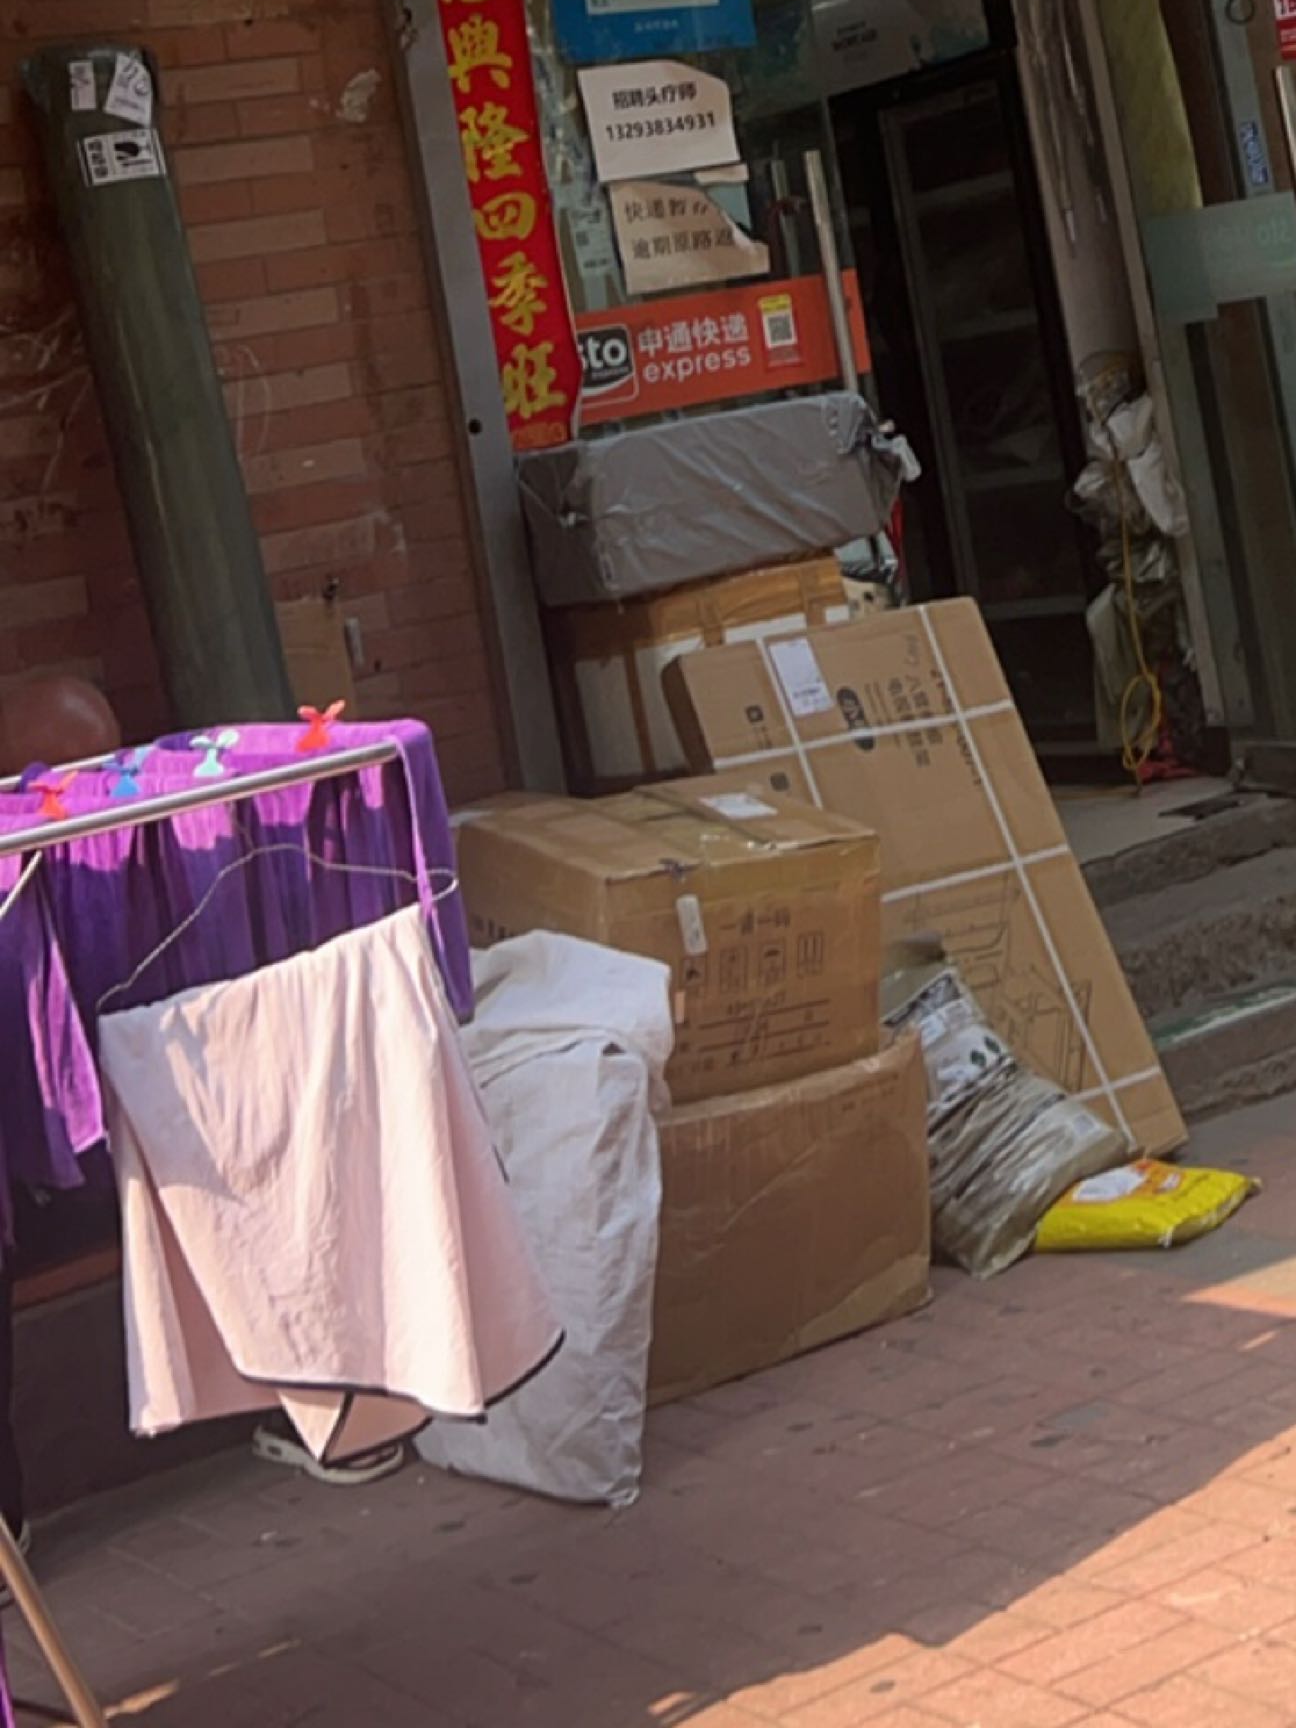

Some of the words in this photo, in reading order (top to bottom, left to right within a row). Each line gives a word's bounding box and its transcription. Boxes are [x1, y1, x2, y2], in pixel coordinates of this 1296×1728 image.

[638, 312, 749, 357] 申通快递
[642, 346, 751, 382] express
